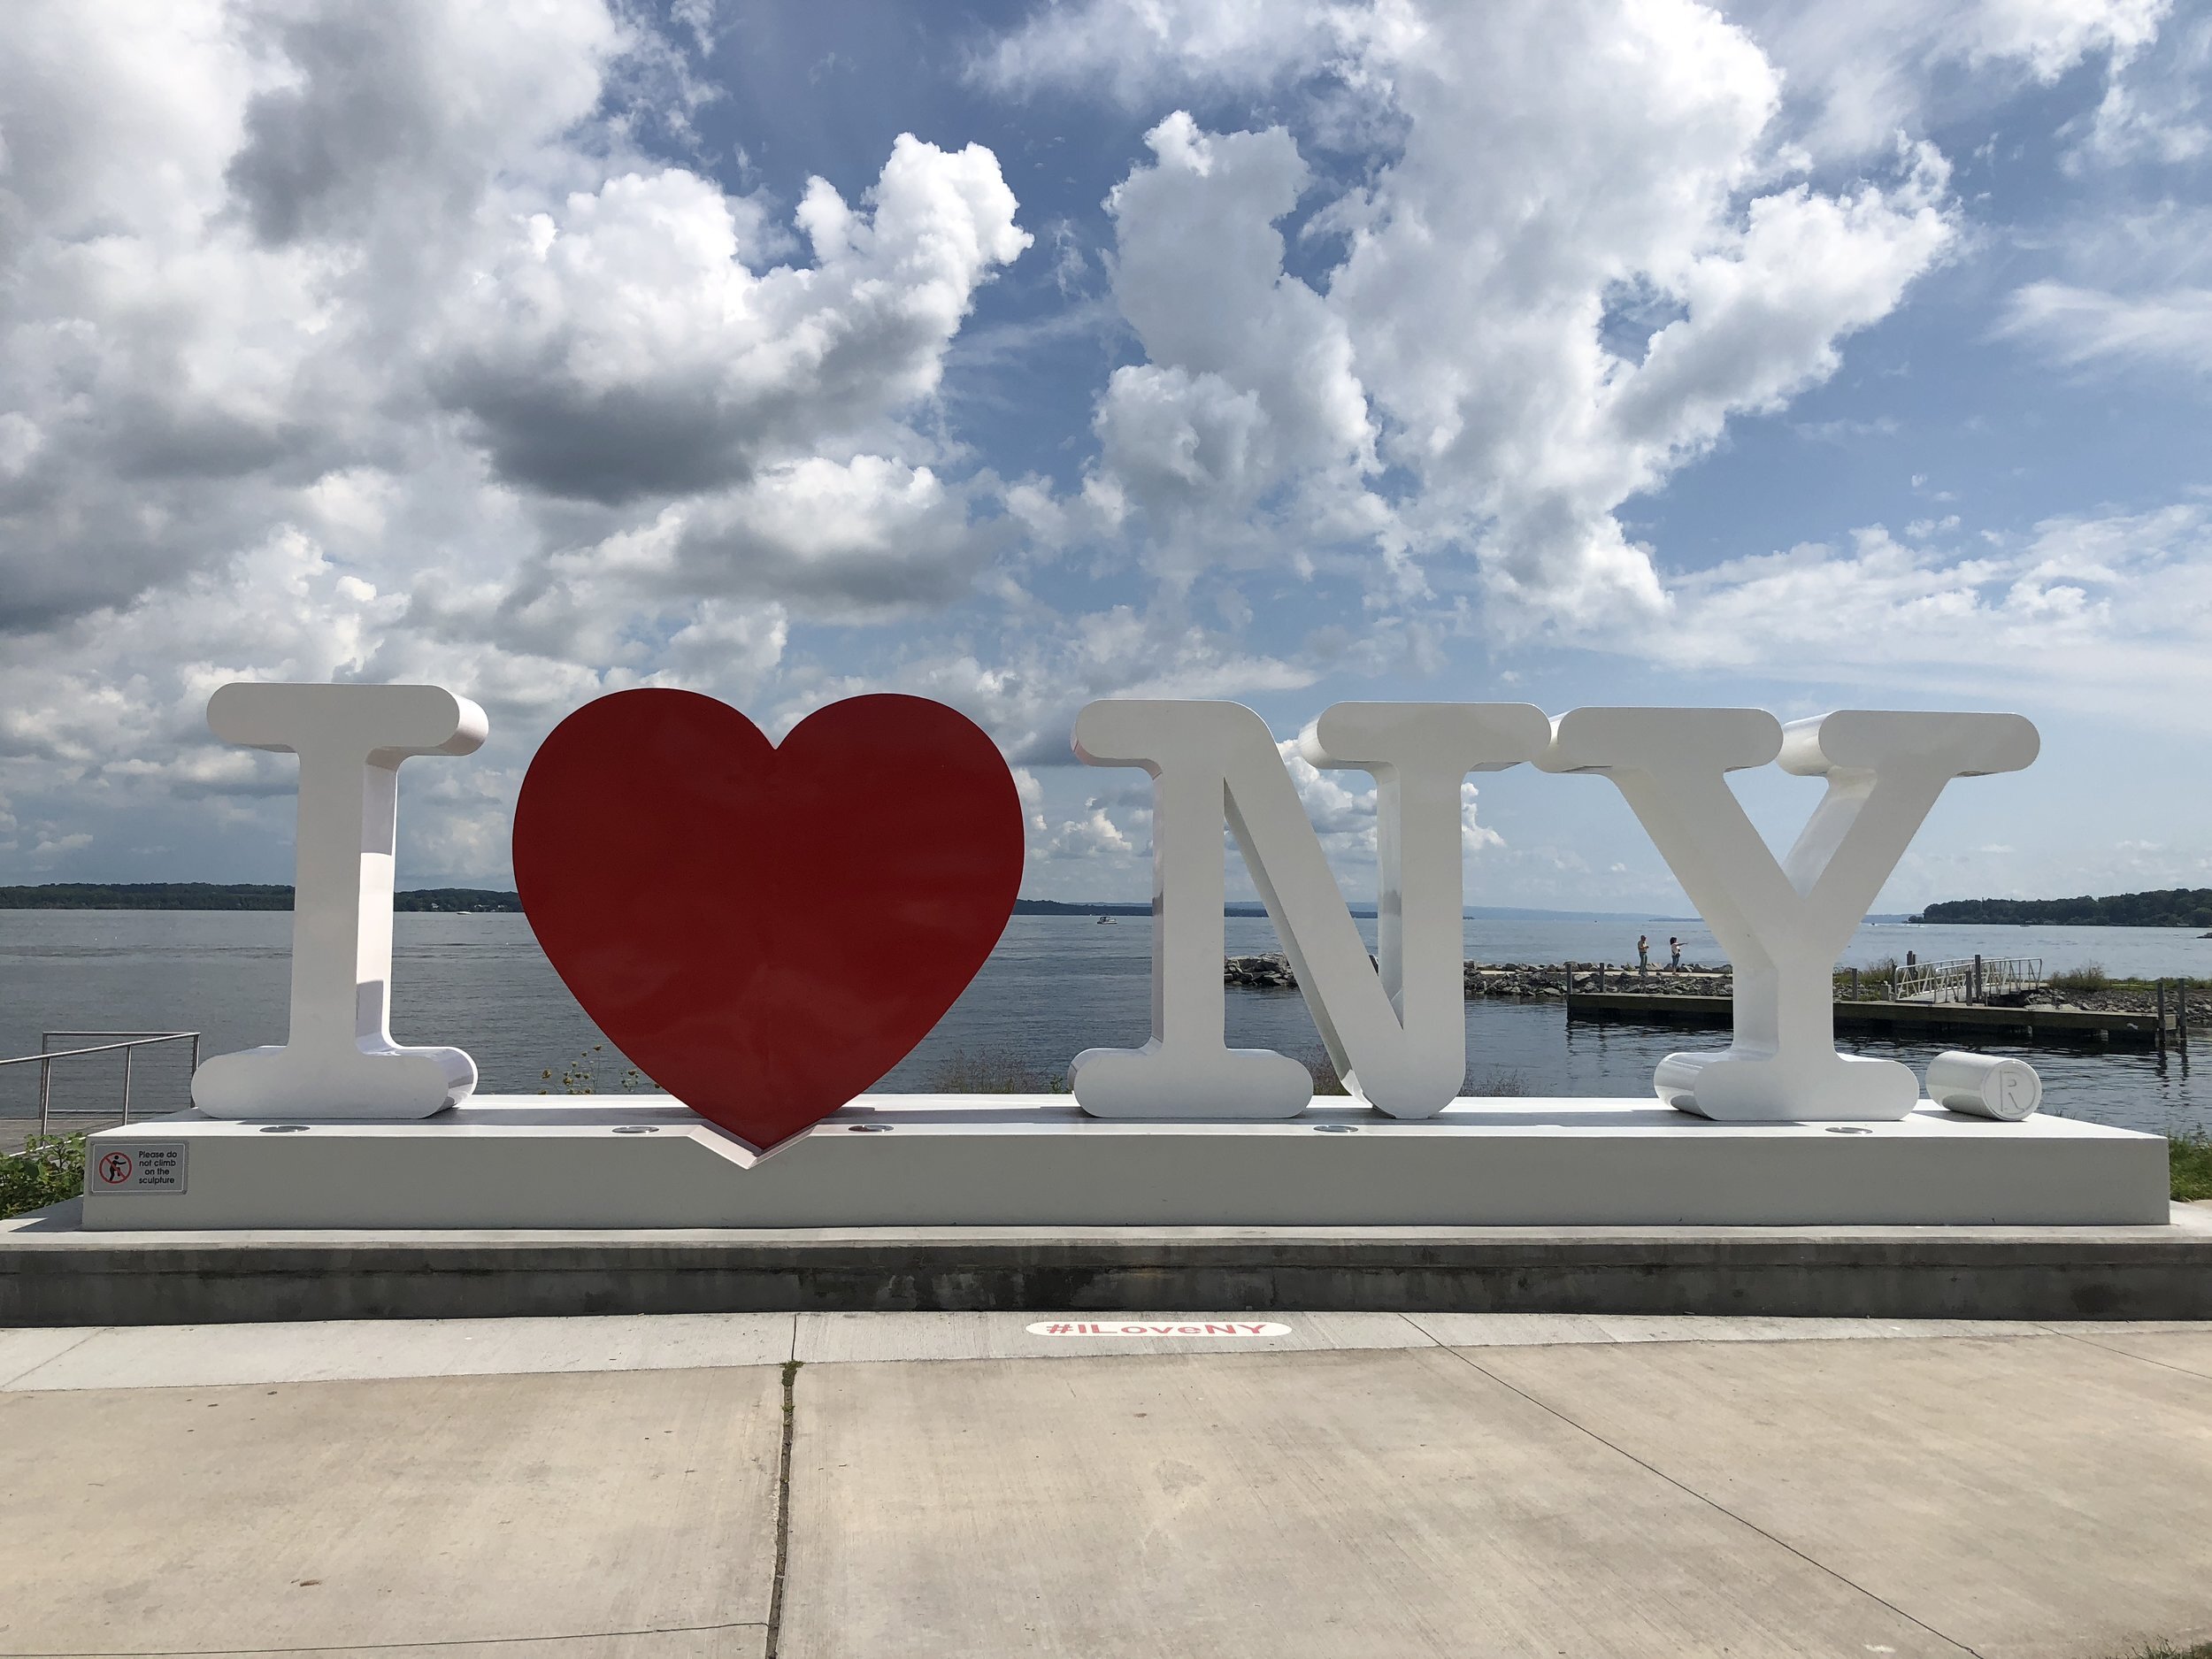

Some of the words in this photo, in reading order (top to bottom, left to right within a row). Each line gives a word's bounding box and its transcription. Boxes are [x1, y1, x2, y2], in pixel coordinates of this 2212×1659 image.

[191, 683, 488, 1121] I
[1071, 700, 2040, 1121] NY
[1046, 1324, 1267, 1334] #ILoveNY
